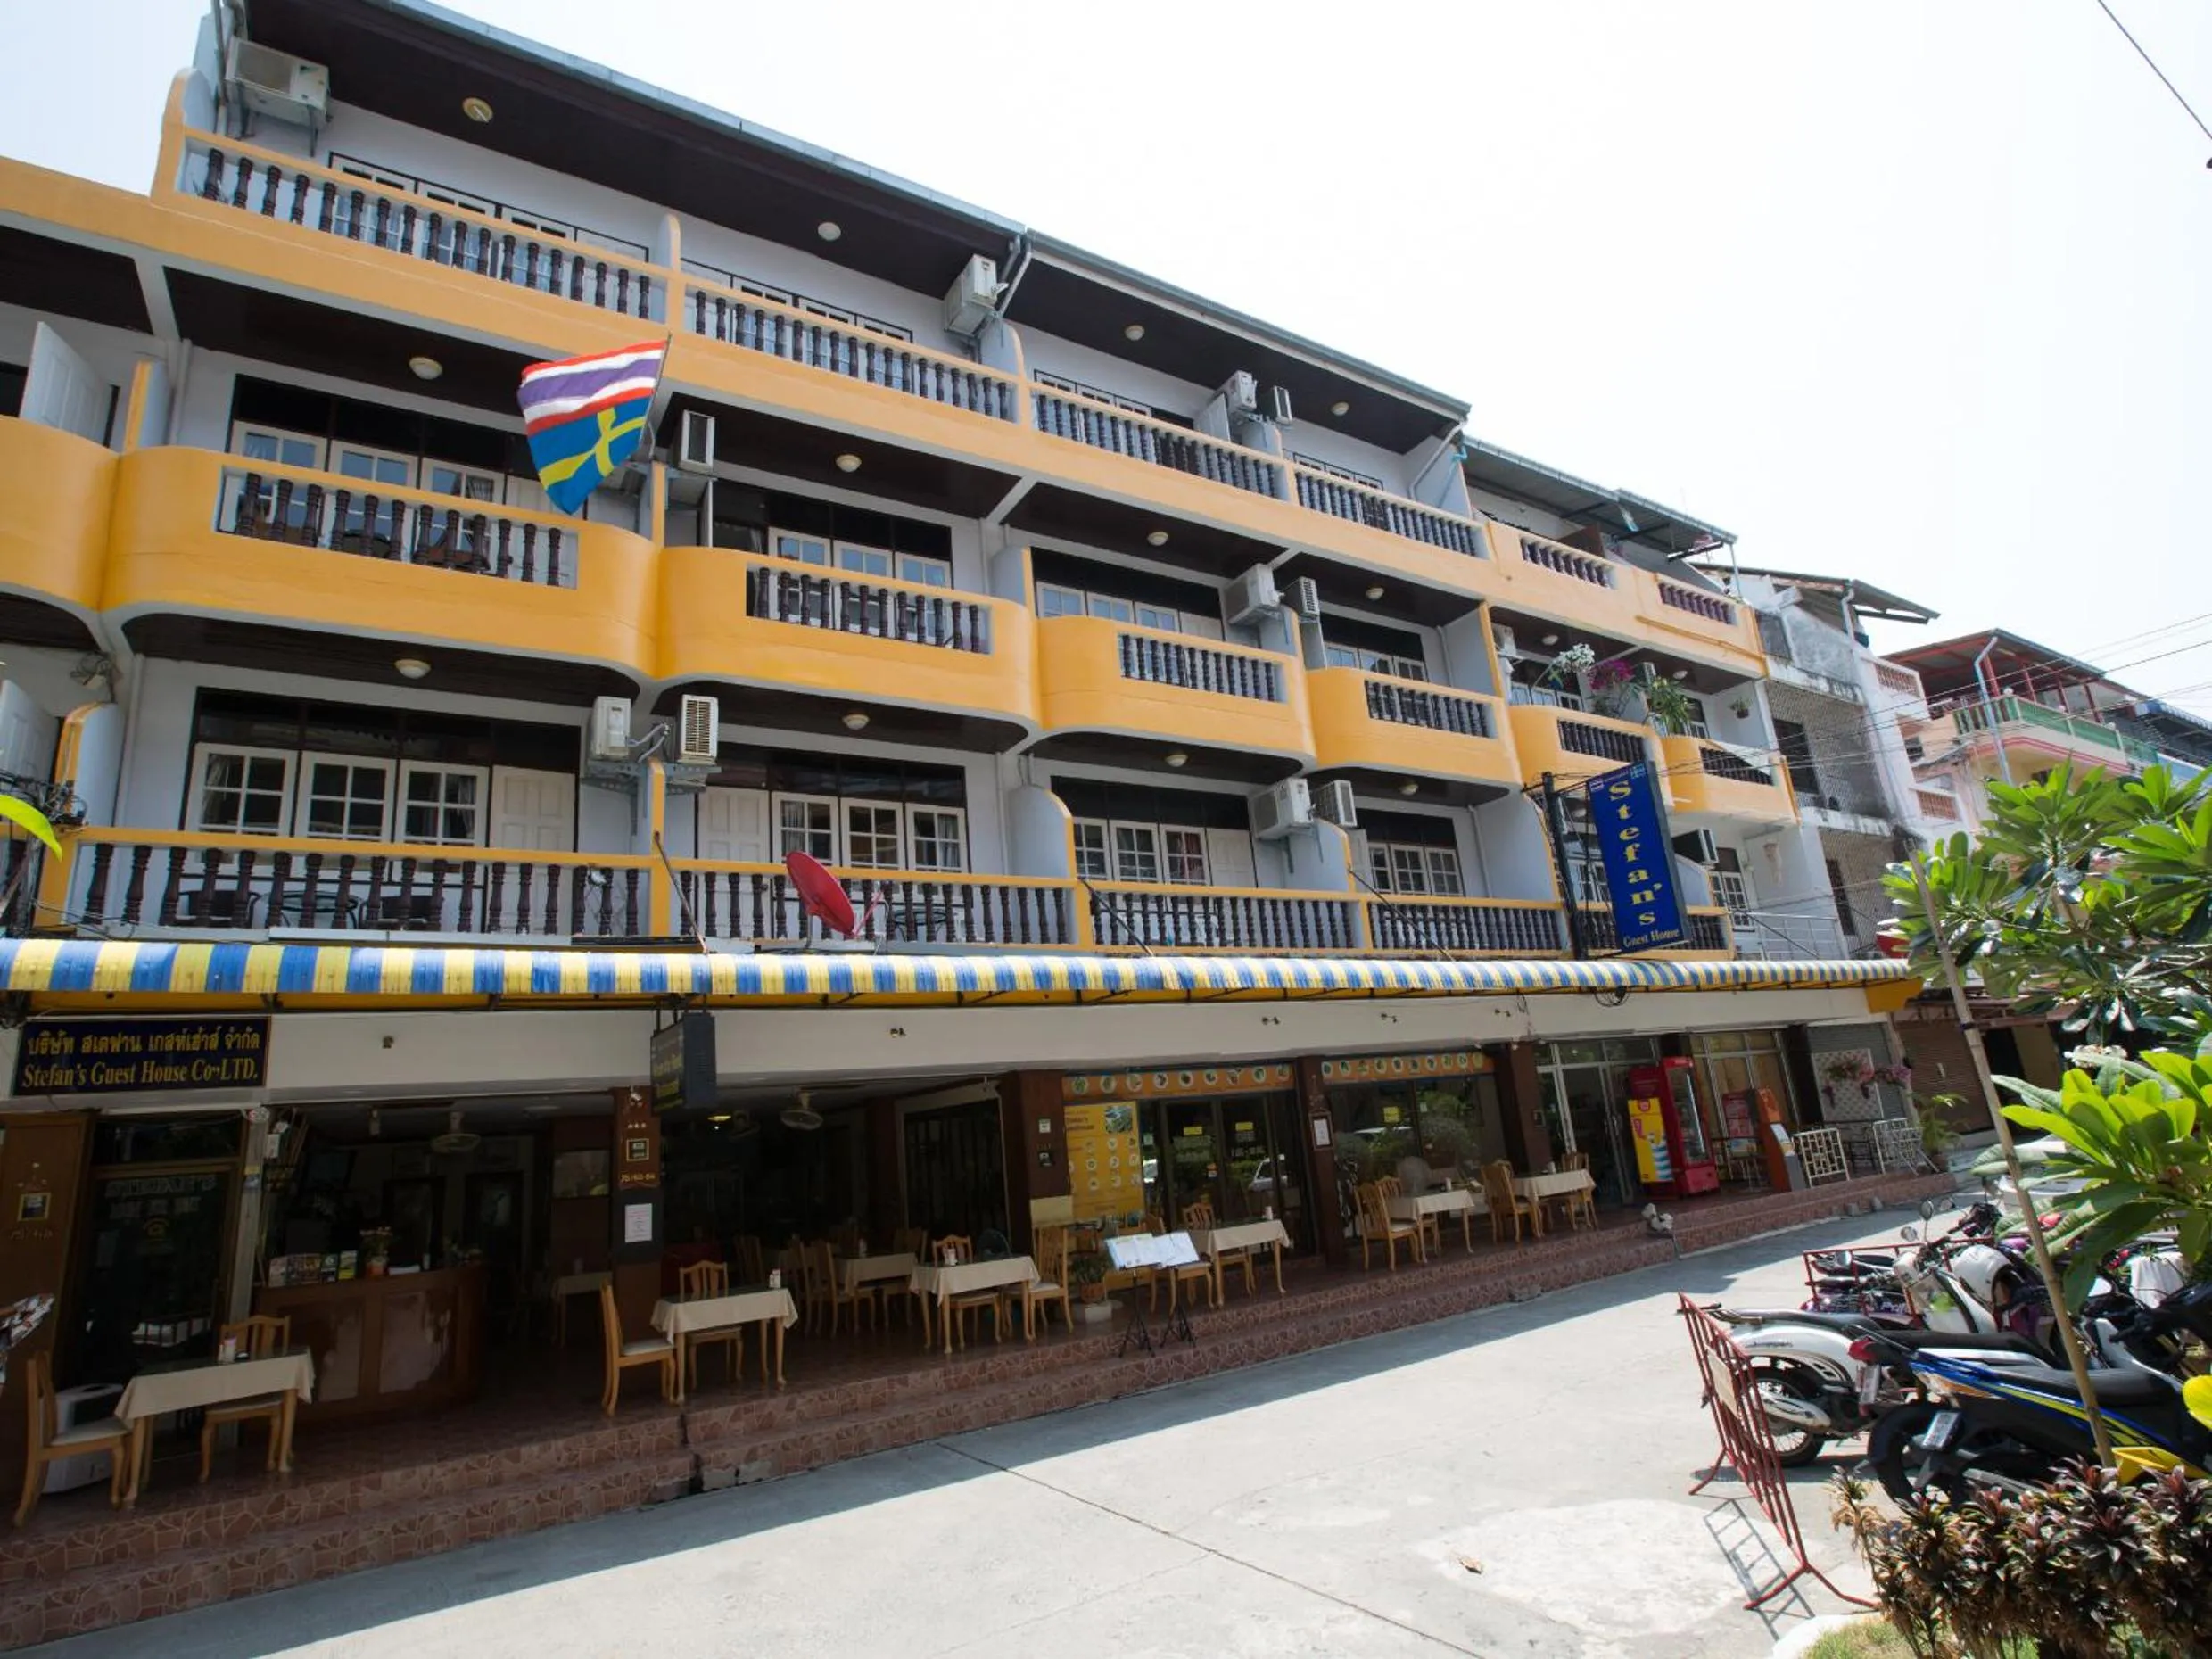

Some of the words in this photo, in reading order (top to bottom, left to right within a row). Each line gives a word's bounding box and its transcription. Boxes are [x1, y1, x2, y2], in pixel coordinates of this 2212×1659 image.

[1608, 780, 1663, 926] Stefan's
[1622, 934, 1648, 948] Guest
[1650, 928, 1680, 942] House
[22, 1061, 87, 1088] Stefan's
[90, 1060, 136, 1085] Guest
[141, 1059, 188, 1083] House
